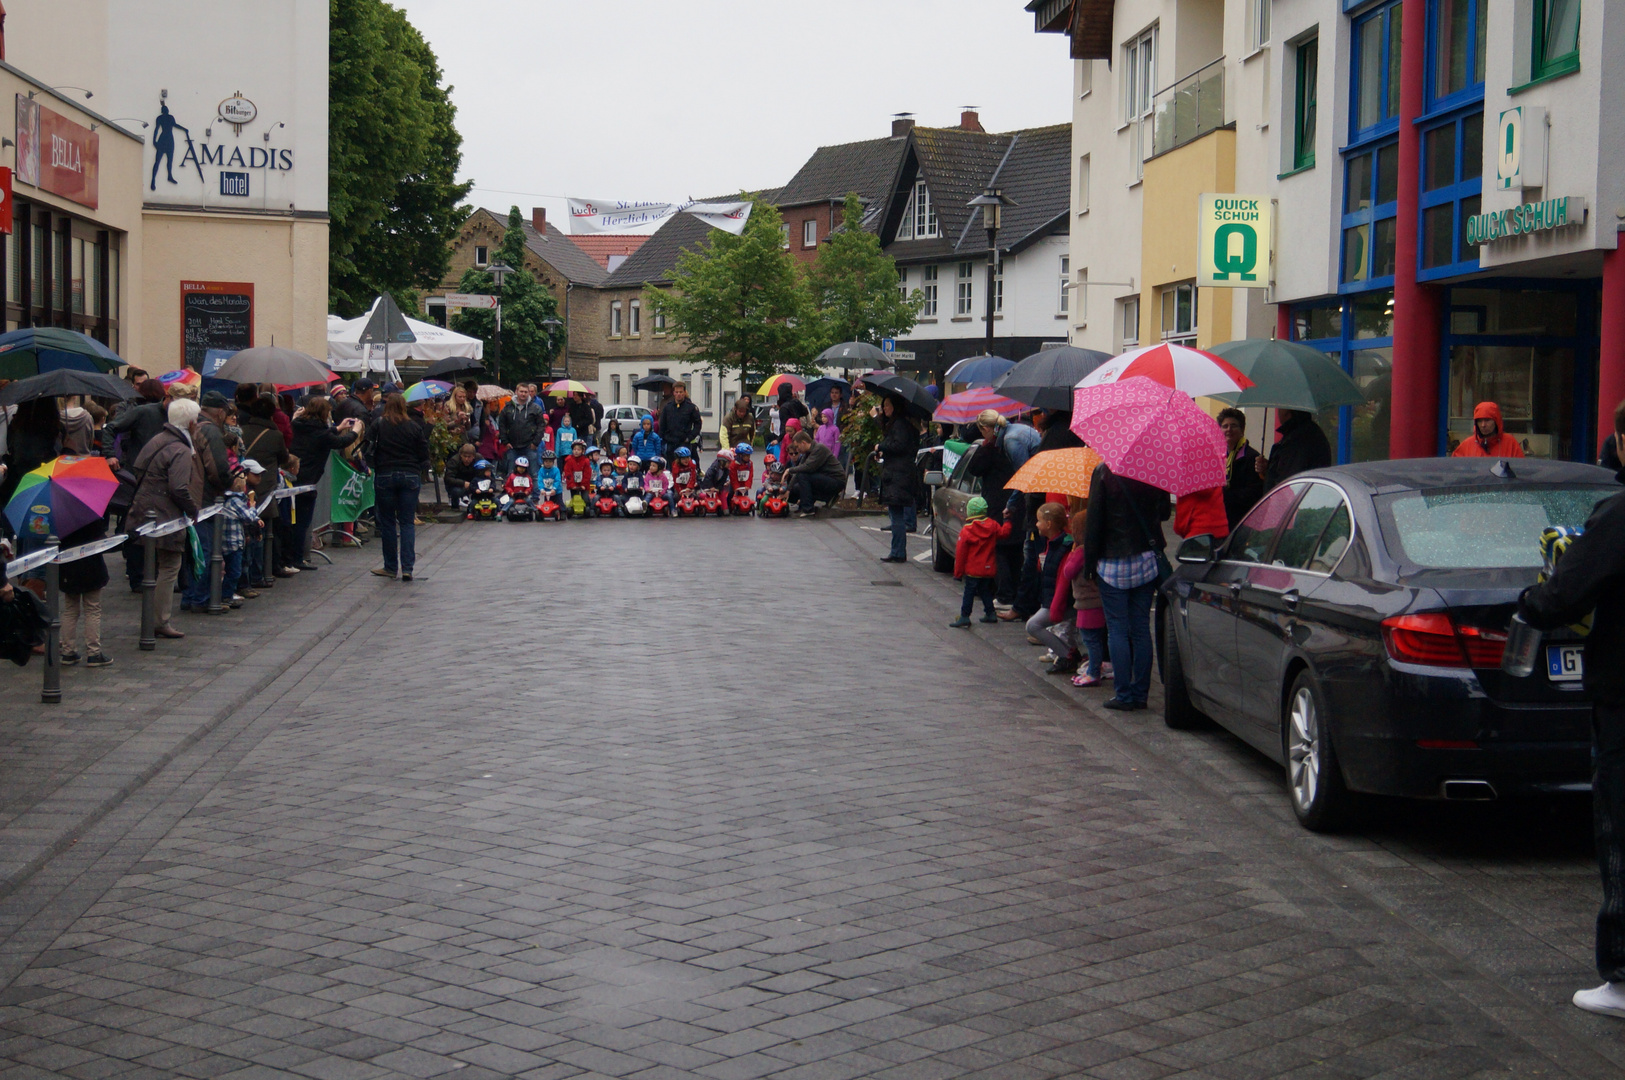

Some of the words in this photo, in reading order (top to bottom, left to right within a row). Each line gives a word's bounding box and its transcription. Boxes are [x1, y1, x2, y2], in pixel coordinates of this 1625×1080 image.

[225, 104, 252, 117] Bitburger
[51, 133, 82, 174] BELLA
[179, 139, 293, 171] AMADIS
[223, 172, 248, 195] hotel
[571, 203, 598, 216] Lucia
[1214, 198, 1259, 211] QUICK
[602, 211, 648, 226] Herzlich
[1214, 210, 1259, 221] SCHUH
[1466, 209, 1509, 246] QUICK
[1513, 196, 1568, 235] SCHUH
[1212, 223, 1258, 282] Q
[183, 283, 206, 291] BELLA
[188, 296, 208, 306] Wein
[209, 295, 223, 305] des
